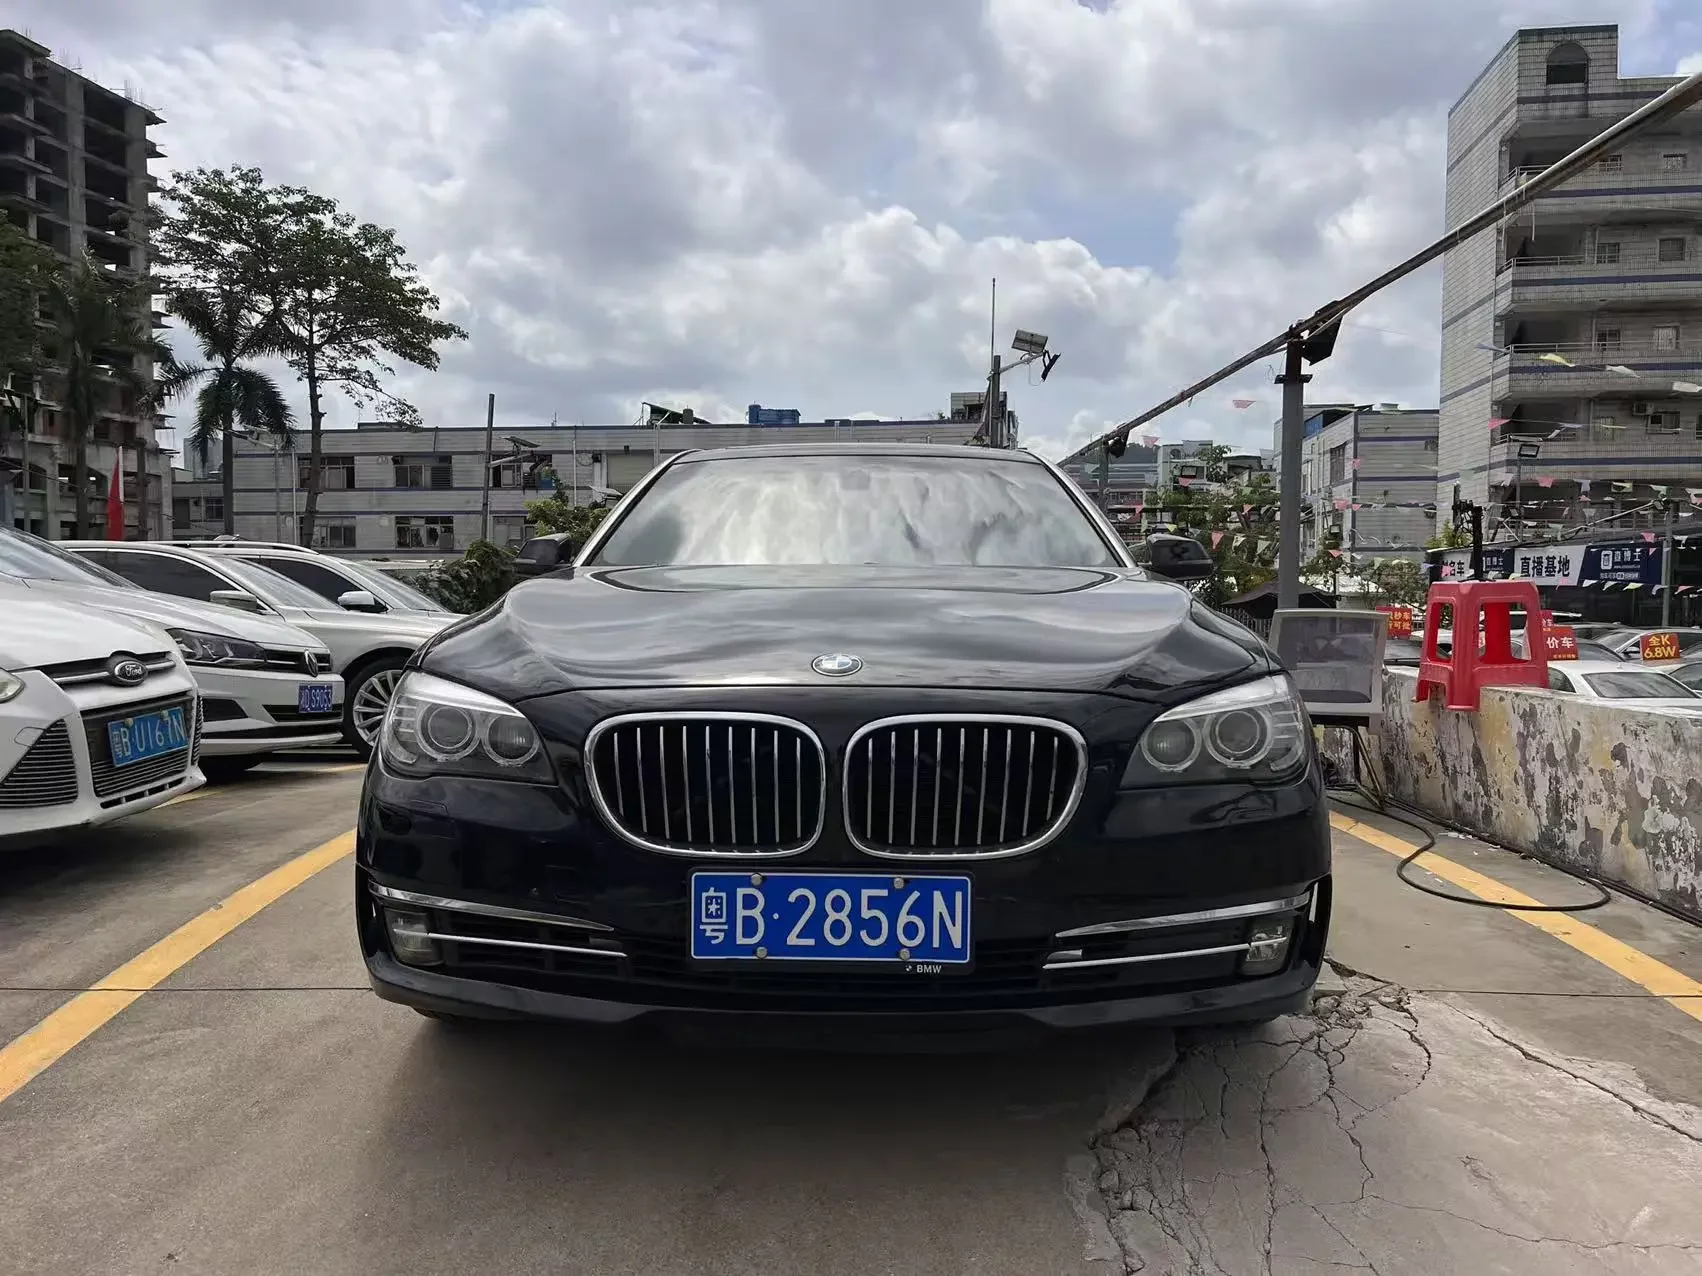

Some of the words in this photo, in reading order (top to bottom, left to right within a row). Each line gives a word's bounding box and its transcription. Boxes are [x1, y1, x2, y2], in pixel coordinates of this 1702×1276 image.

[1520, 555, 1570, 577] 直播基地
[1644, 646, 1676, 659] 6.8W
[125, 664, 142, 676] Ford
[699, 887, 963, 949] 粤B·2856N
[916, 964, 942, 973] BMW
